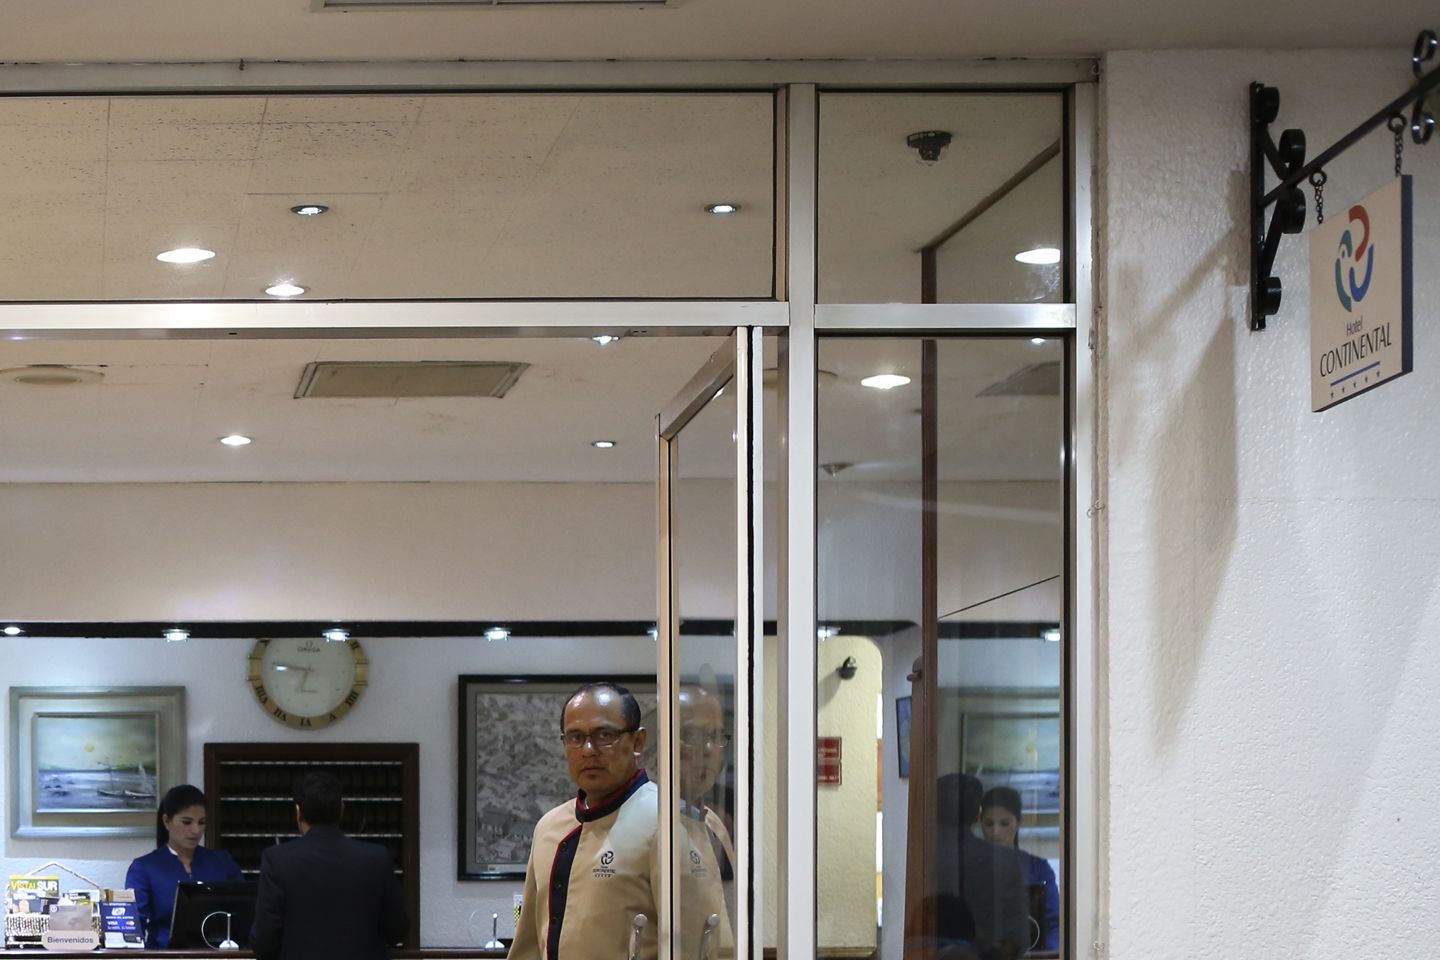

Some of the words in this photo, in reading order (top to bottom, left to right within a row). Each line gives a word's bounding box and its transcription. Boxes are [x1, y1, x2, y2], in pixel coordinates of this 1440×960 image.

[1346, 316, 1363, 337] Hotel
[1320, 322, 1392, 377] CONTINENTAL
[37, 880, 58, 891] SUR
[47, 936, 94, 944] Bienvenidos
